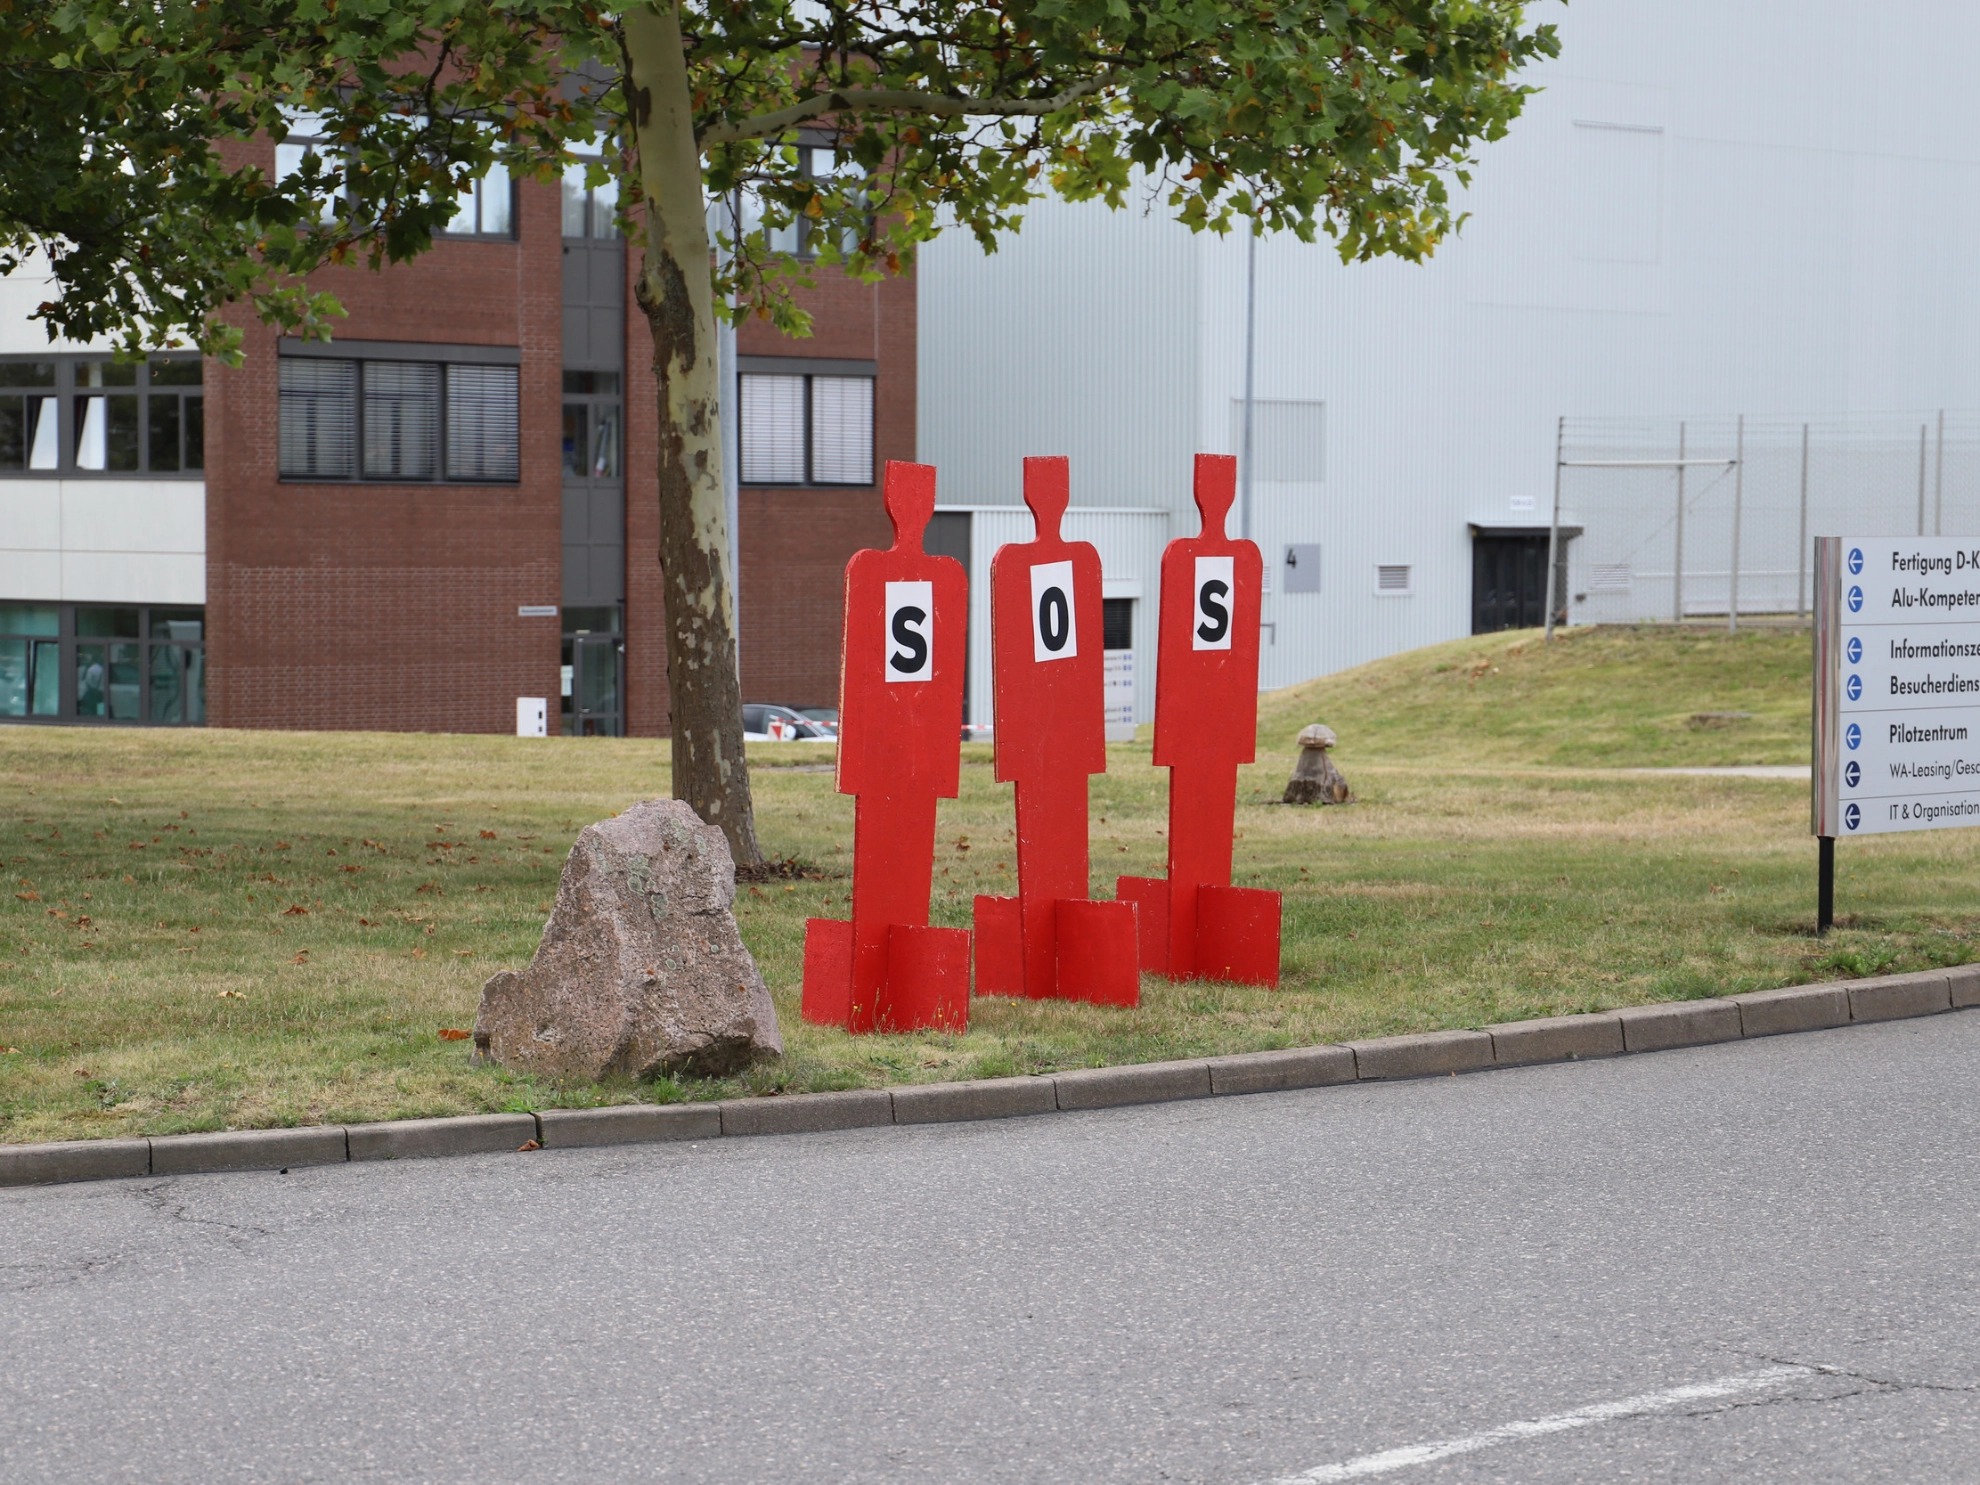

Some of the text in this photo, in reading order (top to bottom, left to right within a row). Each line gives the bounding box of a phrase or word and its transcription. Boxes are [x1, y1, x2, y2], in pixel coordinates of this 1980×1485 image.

[1286, 548, 1296, 569] 4
[1892, 551, 1952, 576] Fertigung
[889, 579, 1229, 674] S O S
[1890, 672, 1980, 695] Besucherdiens
[1889, 723, 1968, 744] Pilotzentrum
[1889, 800, 1980, 822] IT & Organisation
